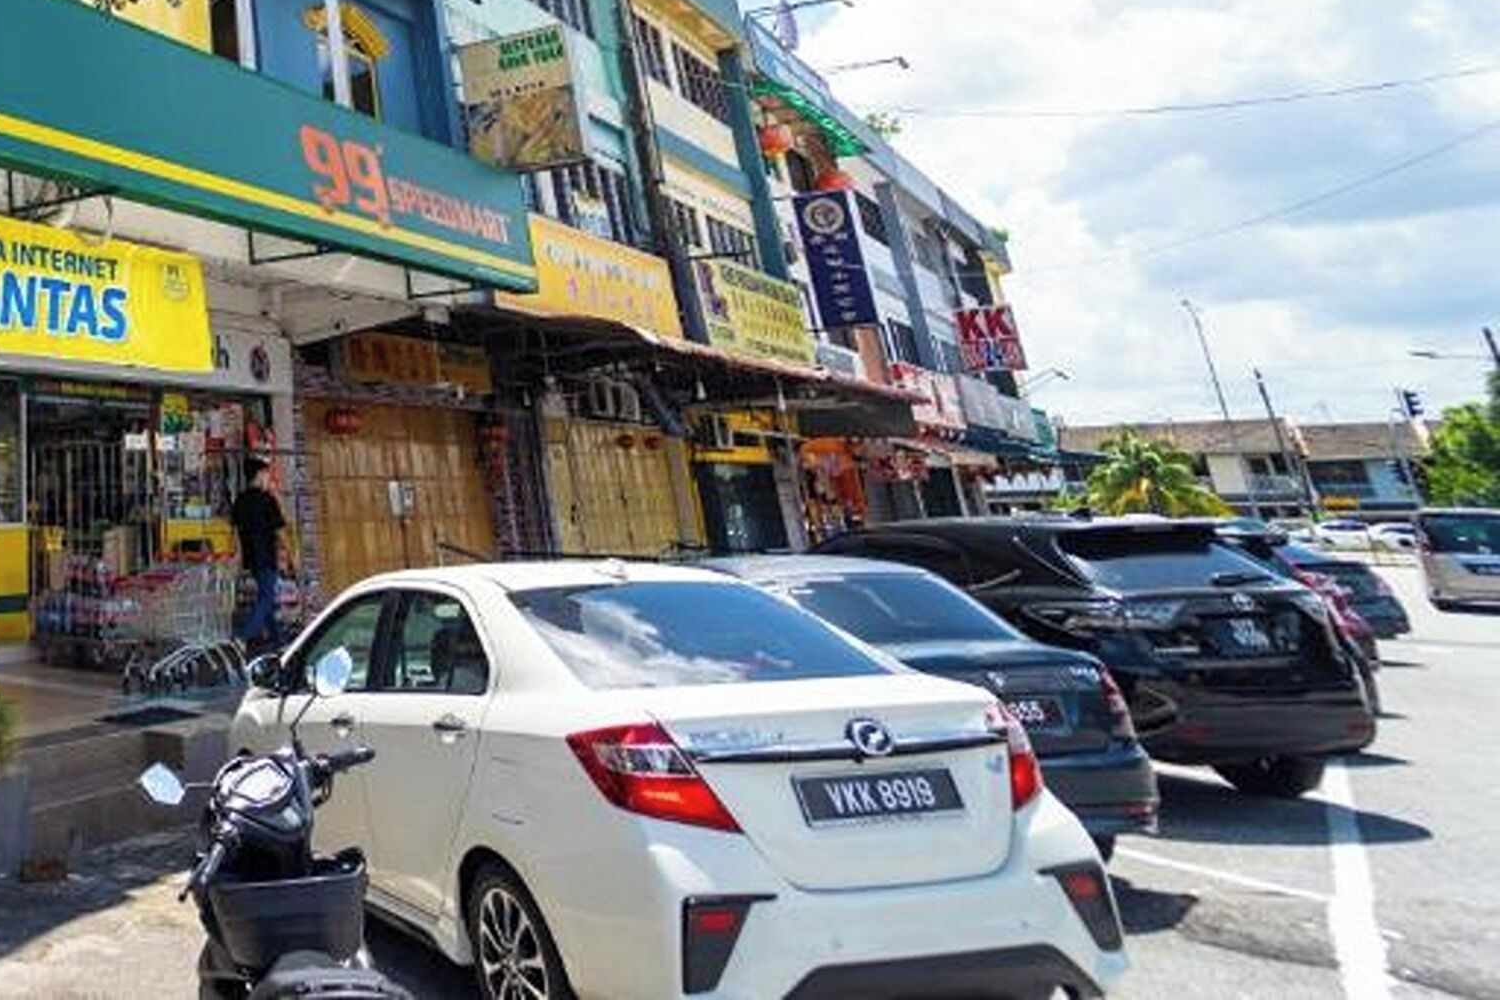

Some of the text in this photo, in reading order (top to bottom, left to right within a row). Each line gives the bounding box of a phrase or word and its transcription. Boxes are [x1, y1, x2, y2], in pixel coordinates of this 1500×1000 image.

[300, 124, 390, 222] 99
[11, 241, 118, 281] INTERNET
[956, 307, 1013, 340] KK
[824, 777, 938, 815] VKK 8919
